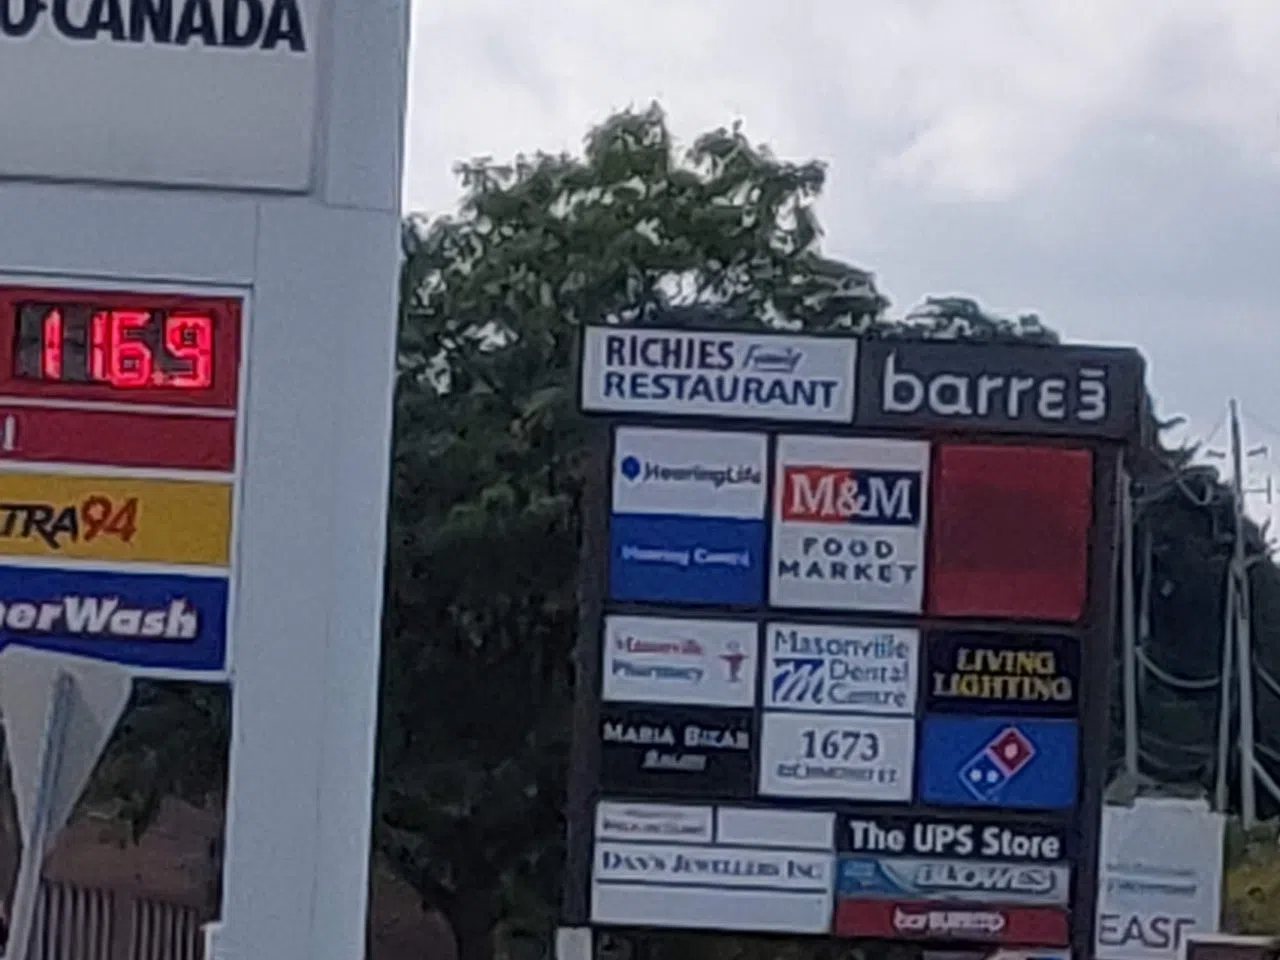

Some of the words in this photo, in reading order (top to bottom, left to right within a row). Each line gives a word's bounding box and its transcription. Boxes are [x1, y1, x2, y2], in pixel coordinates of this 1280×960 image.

[606, 335, 734, 371] RICHIES
[604, 371, 837, 409] RESTAURANT
[789, 474, 914, 520] M&M
[803, 537, 894, 561] FOOD
[778, 560, 916, 585] MARKET
[0, 594, 198, 640] erWash
[774, 631, 908, 659] Masonville
[829, 659, 908, 683] Dental
[957, 647, 1055, 674] LIVING
[932, 672, 1073, 701] LIGHTING
[802, 731, 878, 761] 1673
[850, 820, 905, 851] The
[914, 823, 973, 853] UPS
[981, 827, 1060, 858] Store
